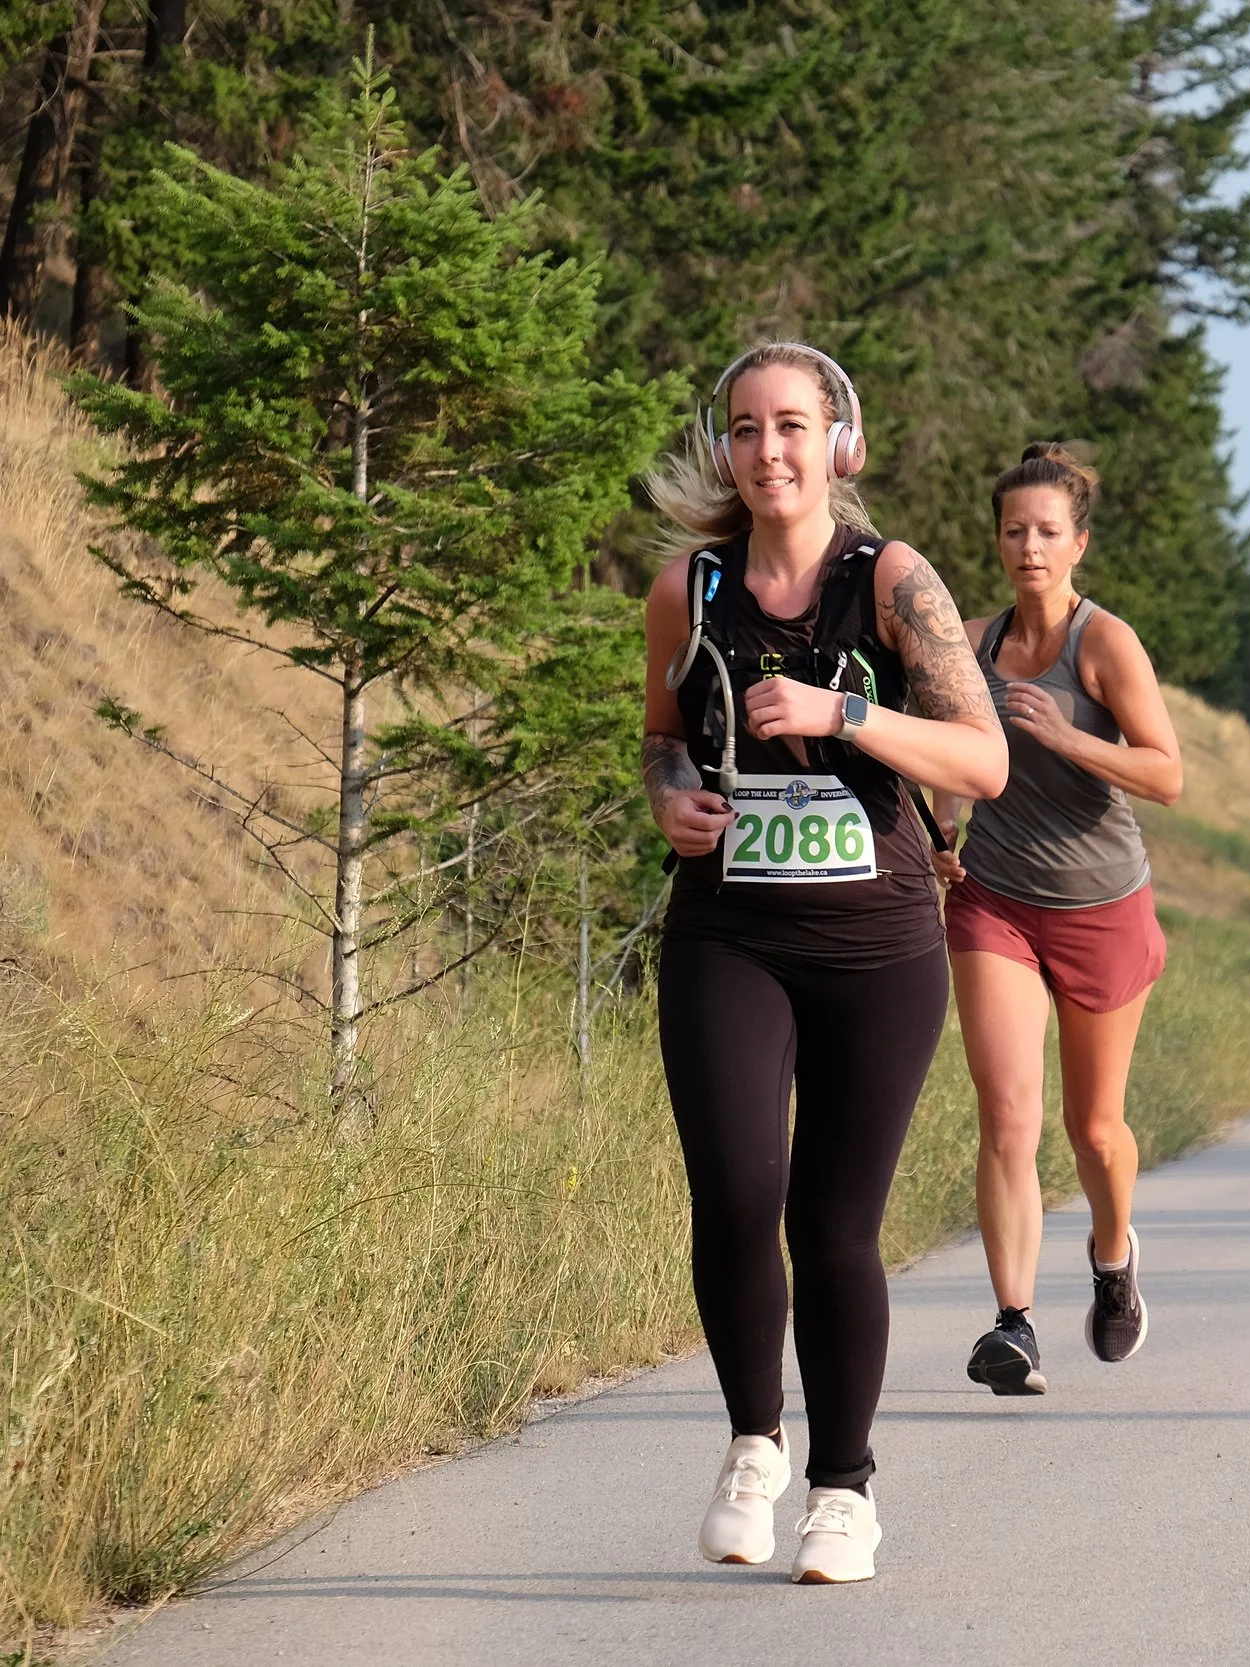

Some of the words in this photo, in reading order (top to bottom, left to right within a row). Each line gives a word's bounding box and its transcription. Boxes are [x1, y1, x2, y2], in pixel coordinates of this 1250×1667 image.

[763, 790, 777, 798] LAKE
[732, 812, 864, 863] 2086
[767, 869, 828, 877] www.loopthelake.ca
